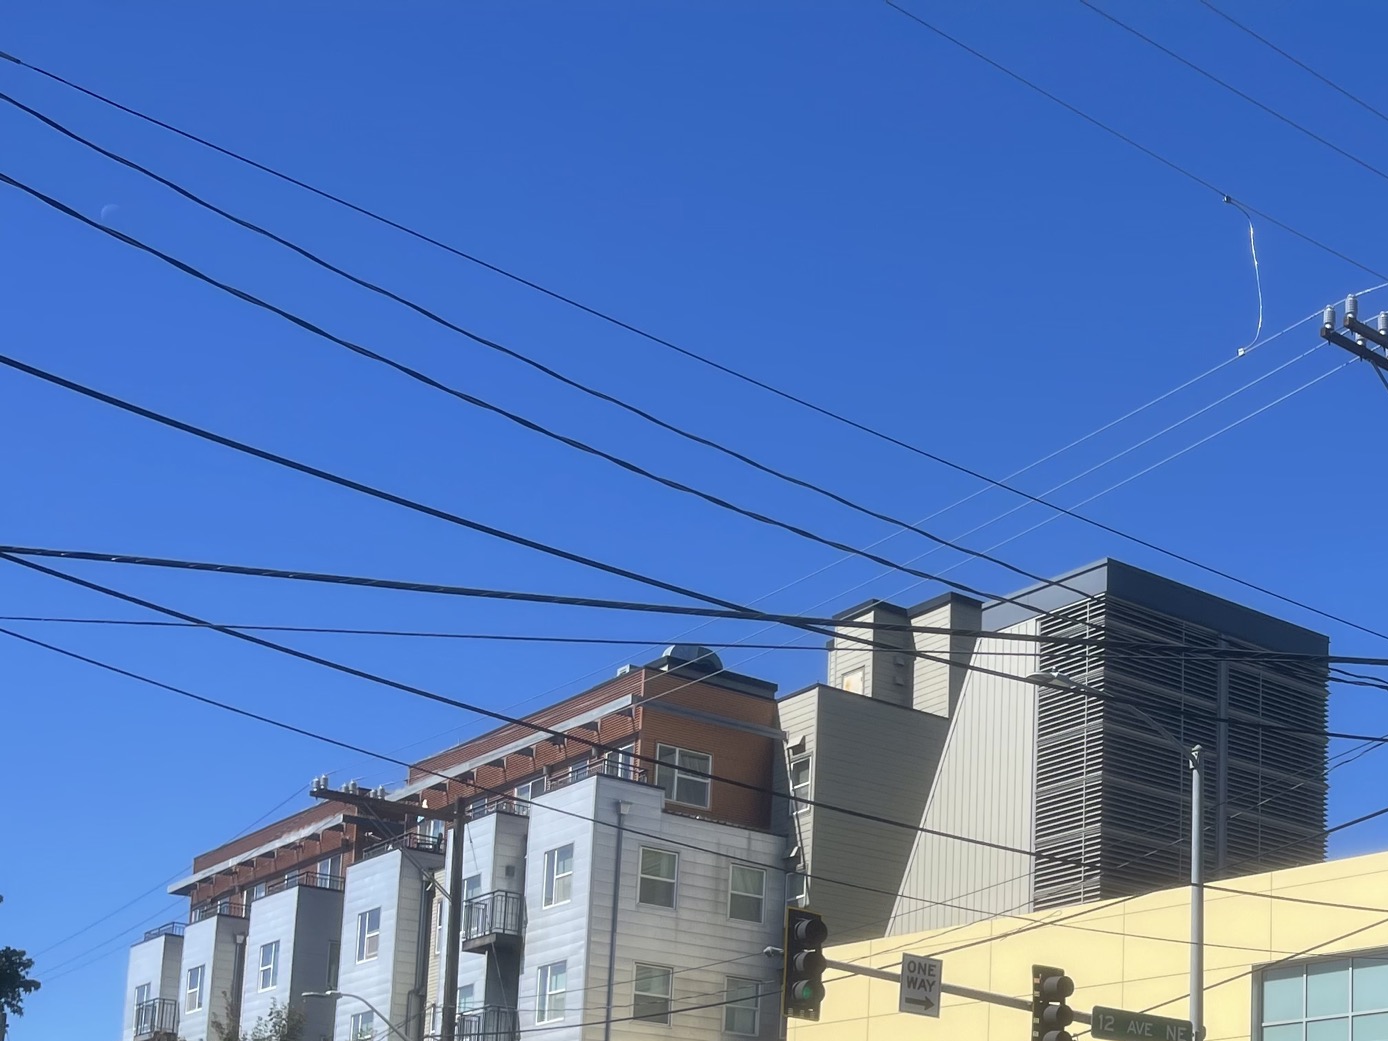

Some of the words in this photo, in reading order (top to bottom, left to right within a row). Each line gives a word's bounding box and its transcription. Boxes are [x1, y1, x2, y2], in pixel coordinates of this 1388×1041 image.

[907, 960, 937, 977] ONE
[906, 975, 937, 992] WAY
[1098, 1014, 1115, 1032] 12
[1126, 1020, 1153, 1037] AVE
[1165, 1025, 1187, 1041] NE
